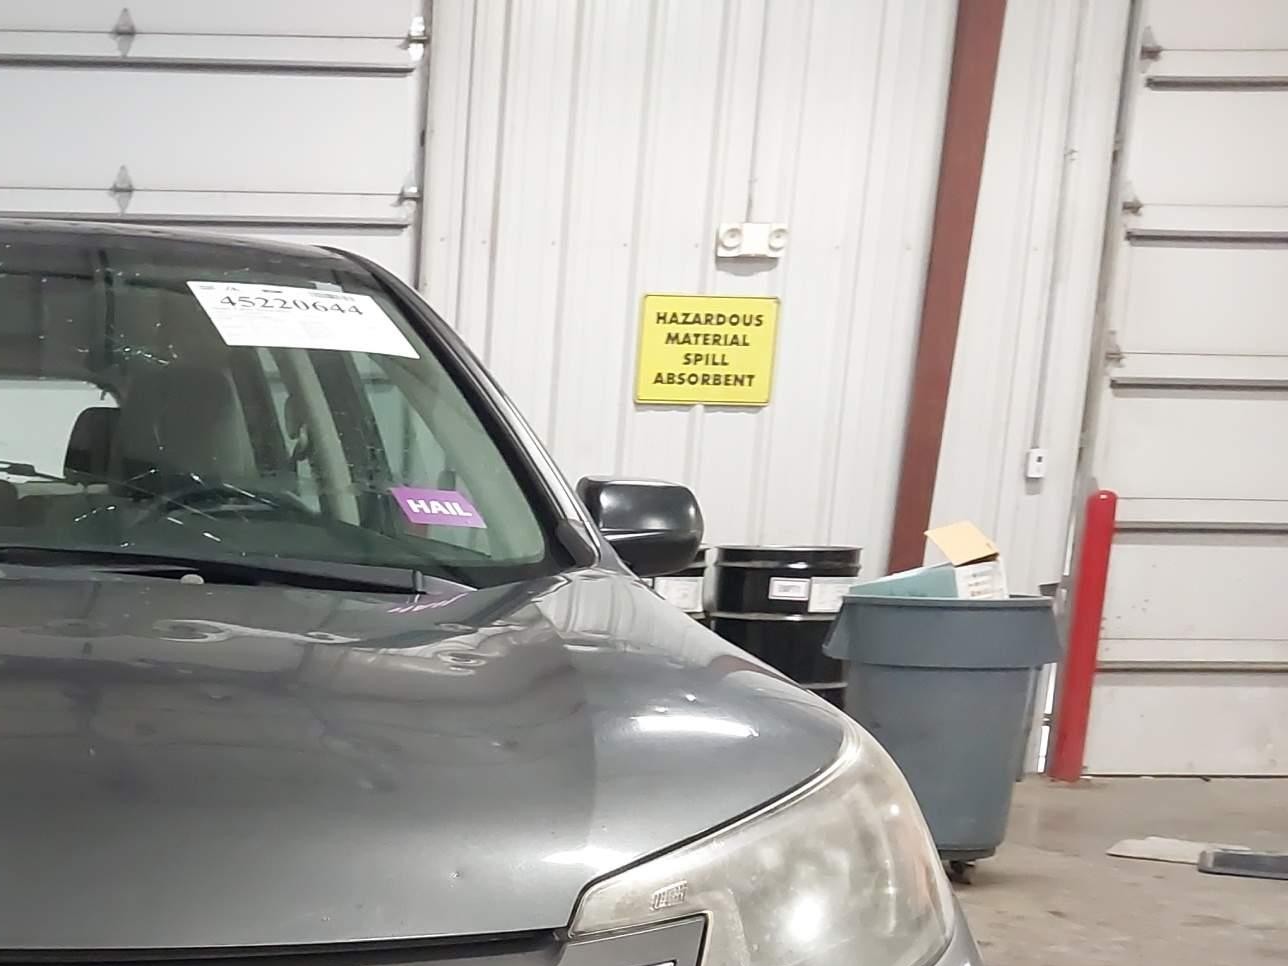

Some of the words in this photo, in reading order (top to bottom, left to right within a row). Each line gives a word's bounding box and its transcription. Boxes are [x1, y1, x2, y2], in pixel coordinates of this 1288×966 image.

[219, 295, 364, 316] 45220644
[656, 311, 765, 327] HAZARDOUS
[665, 332, 751, 347] MATERIAL
[682, 352, 730, 366] SPILL
[652, 372, 756, 387] ABSORBENT
[405, 498, 473, 517] HAIL
